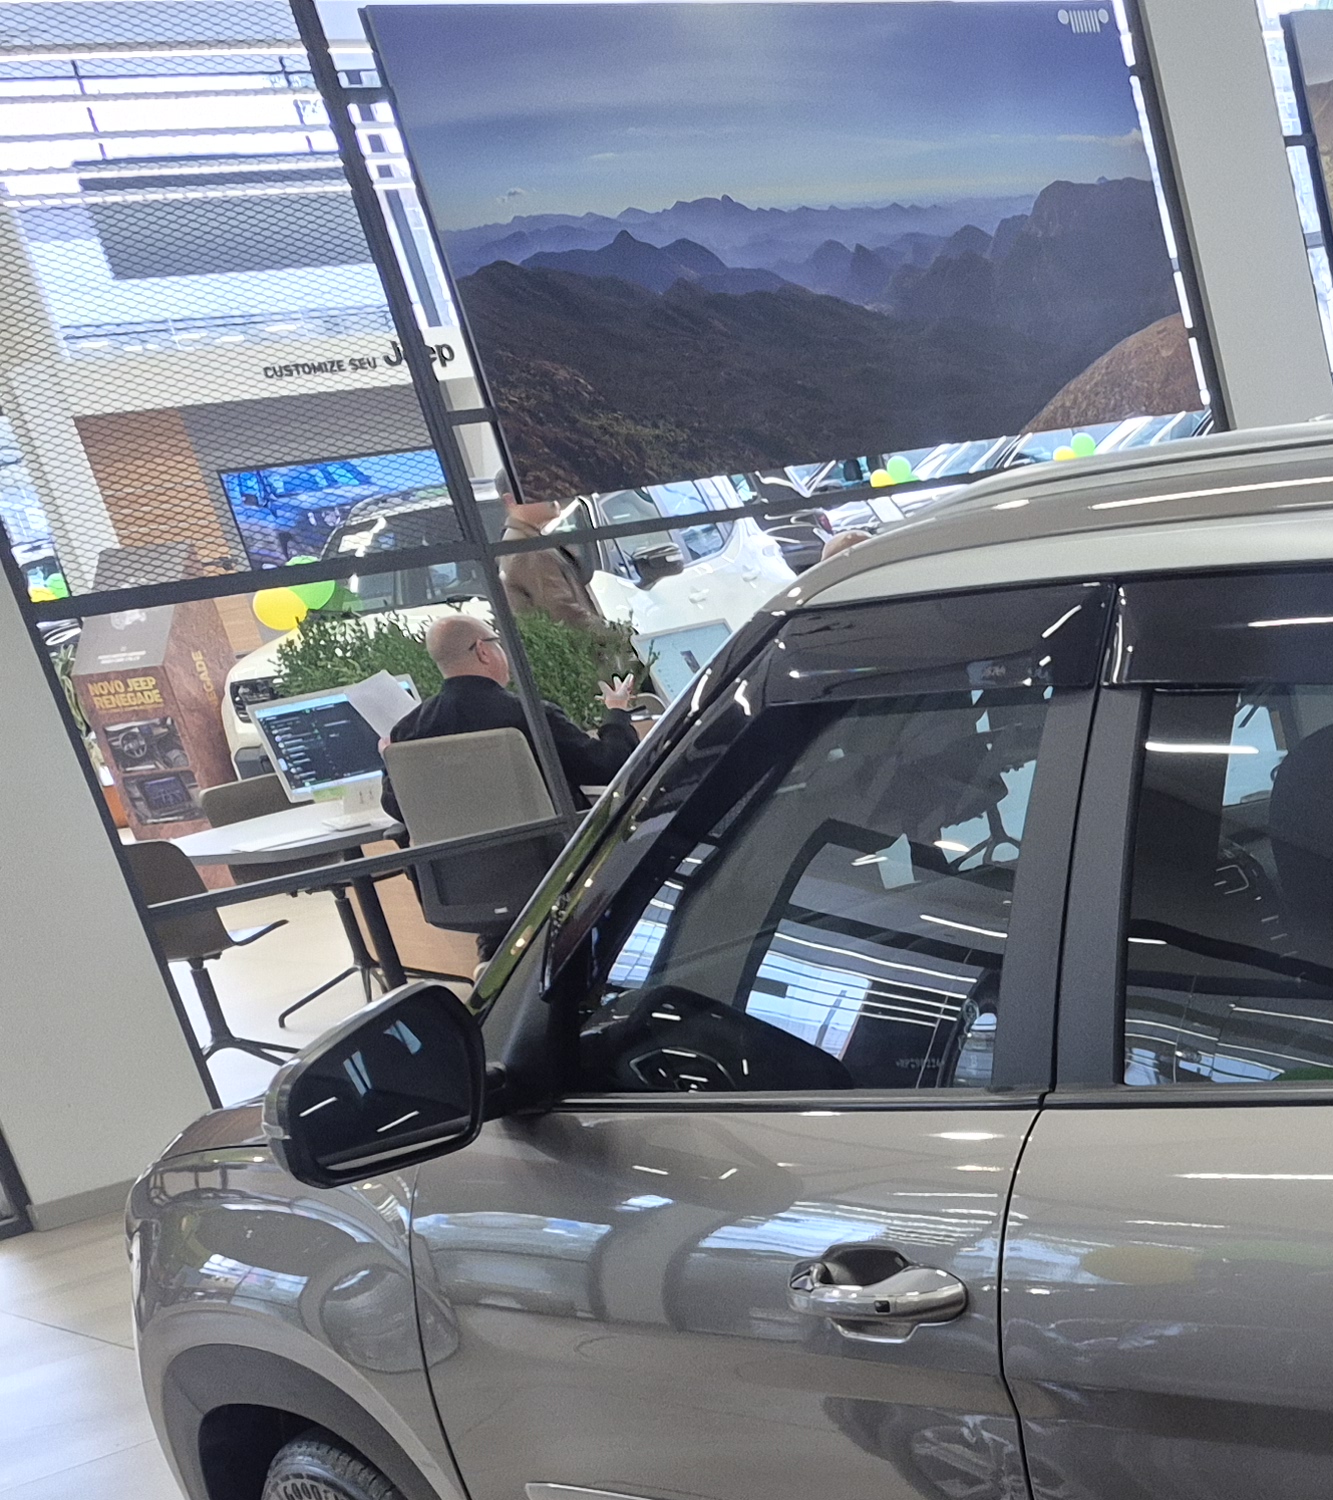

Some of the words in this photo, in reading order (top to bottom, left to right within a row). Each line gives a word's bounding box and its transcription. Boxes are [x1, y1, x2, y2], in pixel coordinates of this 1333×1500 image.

[263, 360, 346, 379] CUSTOMIZE
[349, 357, 378, 372] SEU
[383, 340, 456, 368] Jep
[87, 679, 126, 697] NOVO
[126, 676, 157, 692] JEEP
[92, 689, 164, 710] RENEGADE
